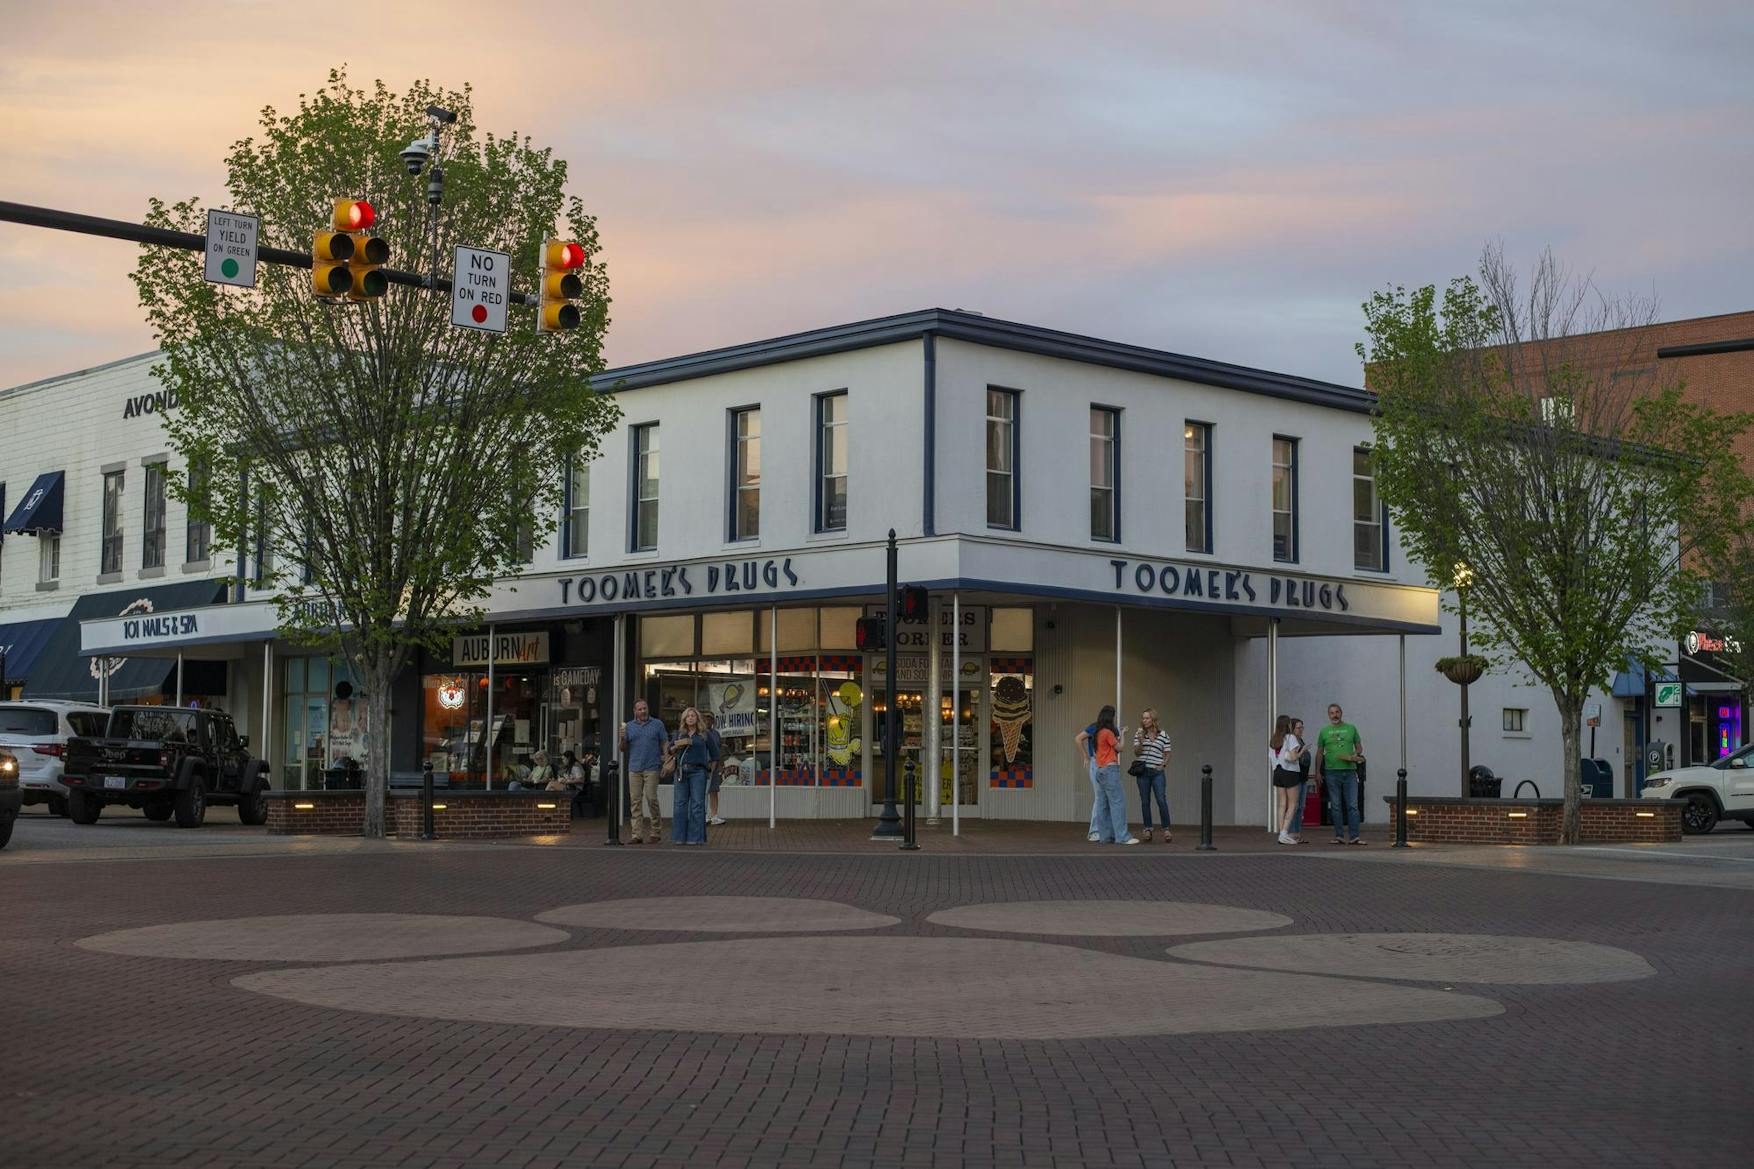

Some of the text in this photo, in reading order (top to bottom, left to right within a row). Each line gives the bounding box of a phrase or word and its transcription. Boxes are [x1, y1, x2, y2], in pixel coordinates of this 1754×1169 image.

[214, 217, 253, 230] LEFT TURN
[220, 229, 246, 244] YIELD
[213, 243, 250, 257] ON GREEN
[471, 254, 494, 271] NO
[468, 272, 496, 288] TURN
[459, 287, 502, 305] ON RED
[558, 558, 798, 604] TOOMER'S DRUGS
[1110, 560, 1349, 611] TOOMER'S DRUGS
[124, 620, 139, 640] 101
[143, 617, 169, 637] NAILS
[561, 668, 600, 686] GAMEDAY
[715, 714, 727, 730] OW
